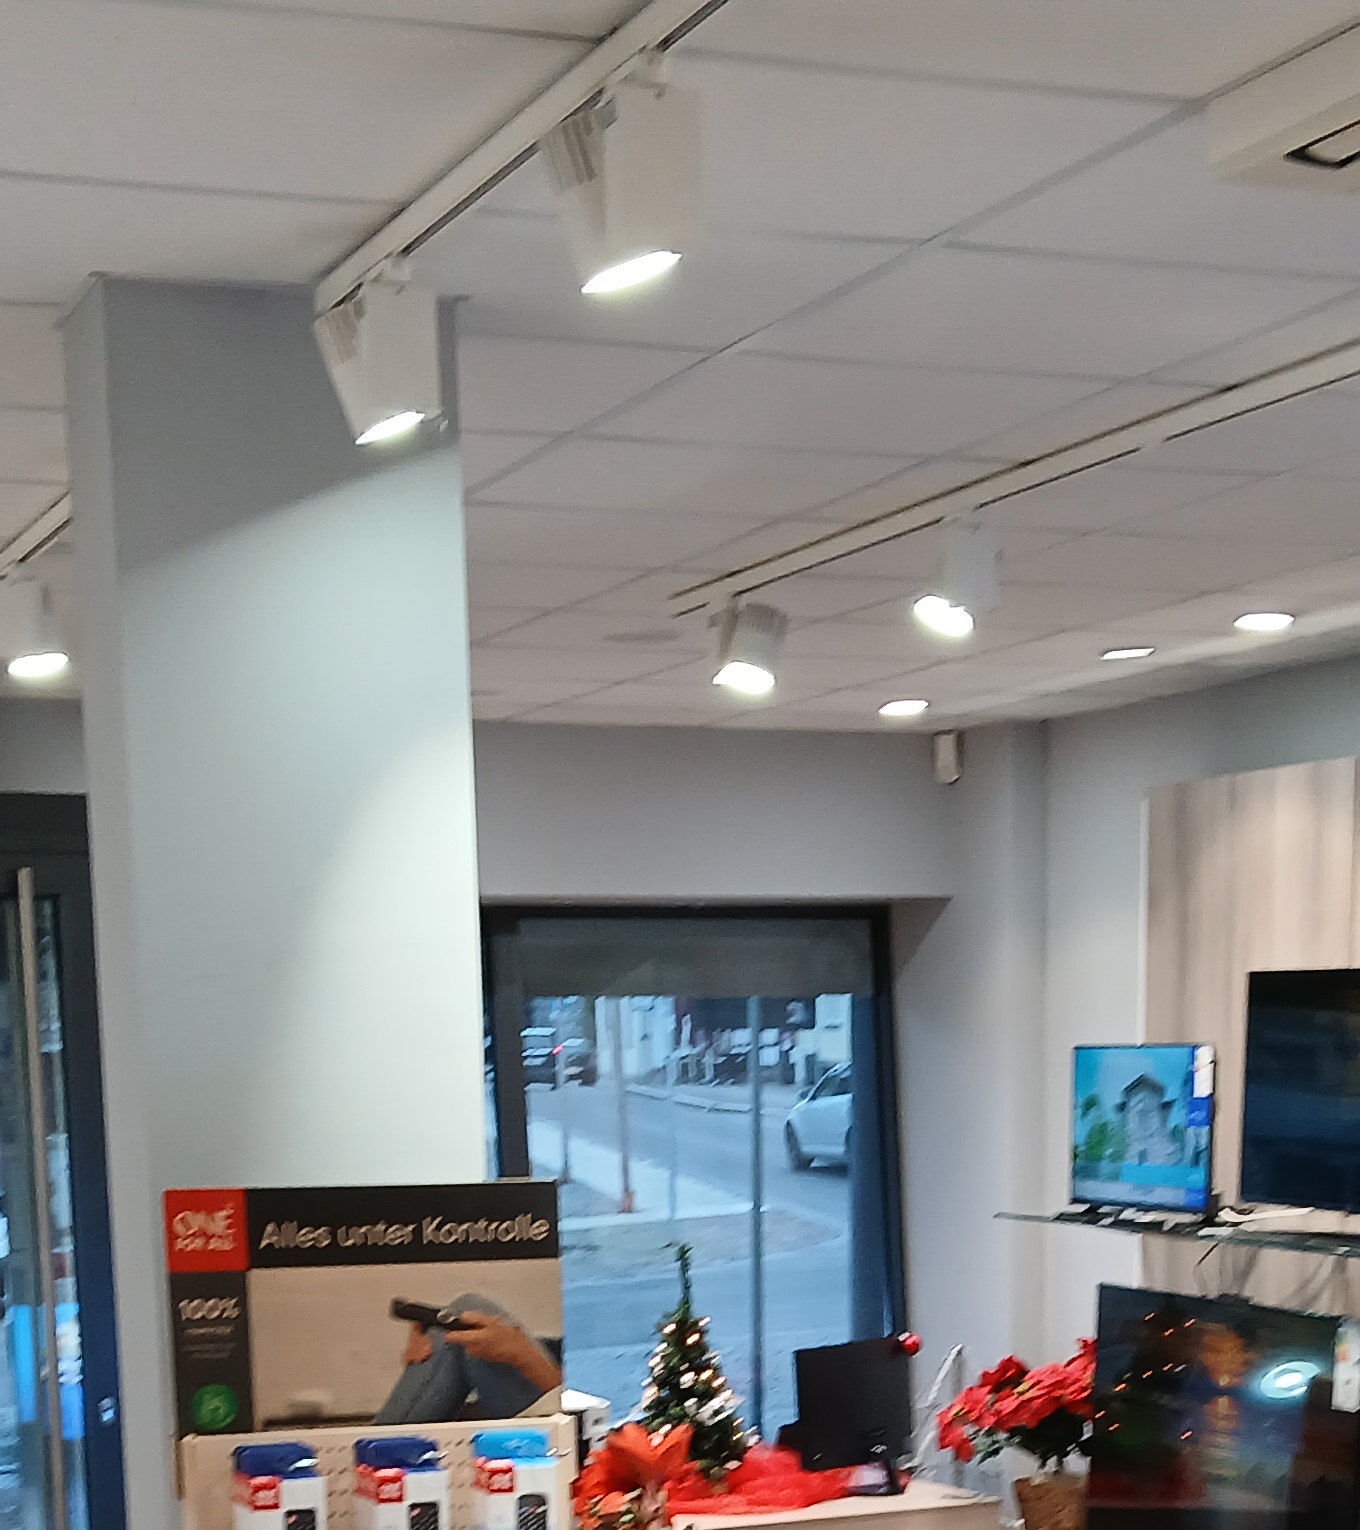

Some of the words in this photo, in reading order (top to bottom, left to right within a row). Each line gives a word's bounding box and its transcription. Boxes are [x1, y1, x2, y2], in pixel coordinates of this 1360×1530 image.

[259, 1219, 333, 1251] Alles
[336, 1219, 418, 1248] unter
[422, 1211, 551, 1246] Kontrolle
[178, 1296, 242, 1320] 100%
